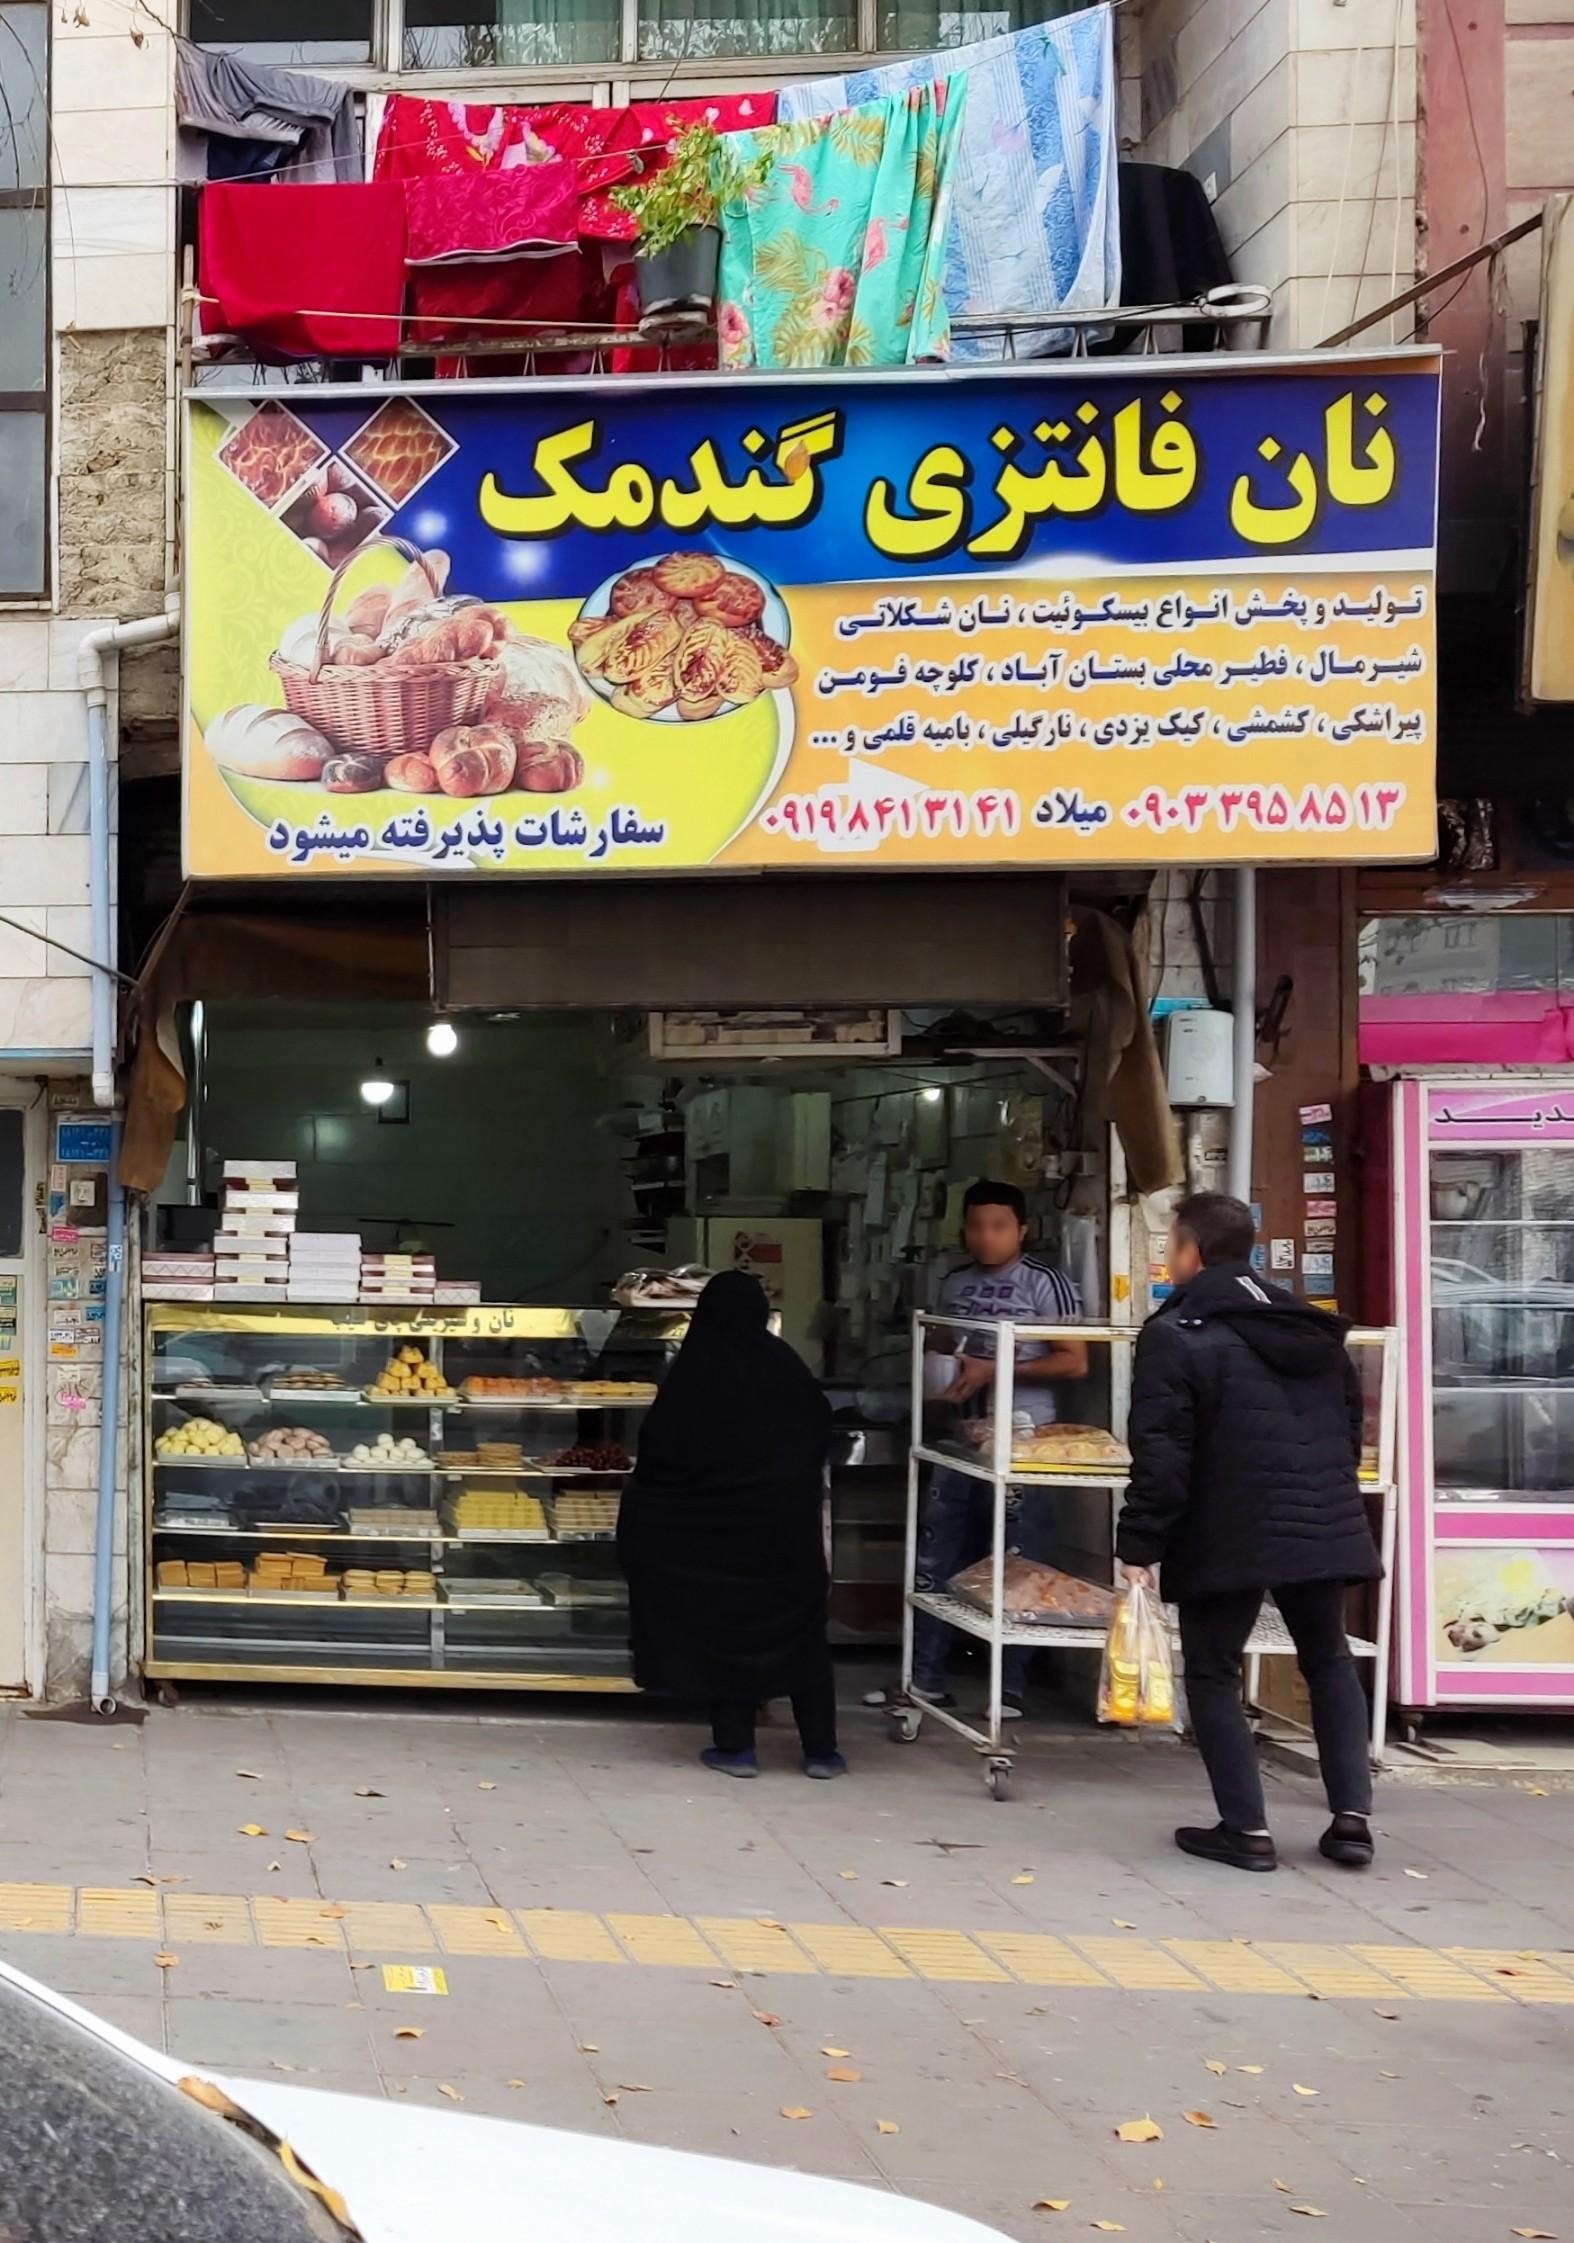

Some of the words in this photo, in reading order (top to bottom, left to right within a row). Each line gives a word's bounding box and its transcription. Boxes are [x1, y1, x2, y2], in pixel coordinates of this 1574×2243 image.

[479, 411, 836, 533] گندمک
[866, 389, 1198, 555] فانتزی
[1230, 390, 1394, 544] نان
[840, 603, 950, 635] شکلاتی
[959, 600, 1009, 632] نان
[1157, 595, 1227, 627] انواع
[1236, 598, 1306, 625] پخش
[1315, 602, 1326, 624] و
[1334, 591, 1421, 622] تولید
[819, 665, 906, 694] فومن
[916, 659, 978, 690] کلوچه
[1069, 657, 1145, 687] بستان
[1154, 655, 1212, 685] محلی
[1220, 652, 1287, 684] فطیر
[843, 729, 857, 752] و
[864, 717, 914, 749] قلمی
[924, 718, 969, 746] بامیه
[1158, 712, 1204, 741] کیک
[1037, 794, 1106, 830] میلاد
[270, 816, 368, 861] میشود
[382, 810, 504, 859] پذیرفته
[516, 810, 663, 856] سفارشات
[1434, 1107, 1574, 1128] دید
